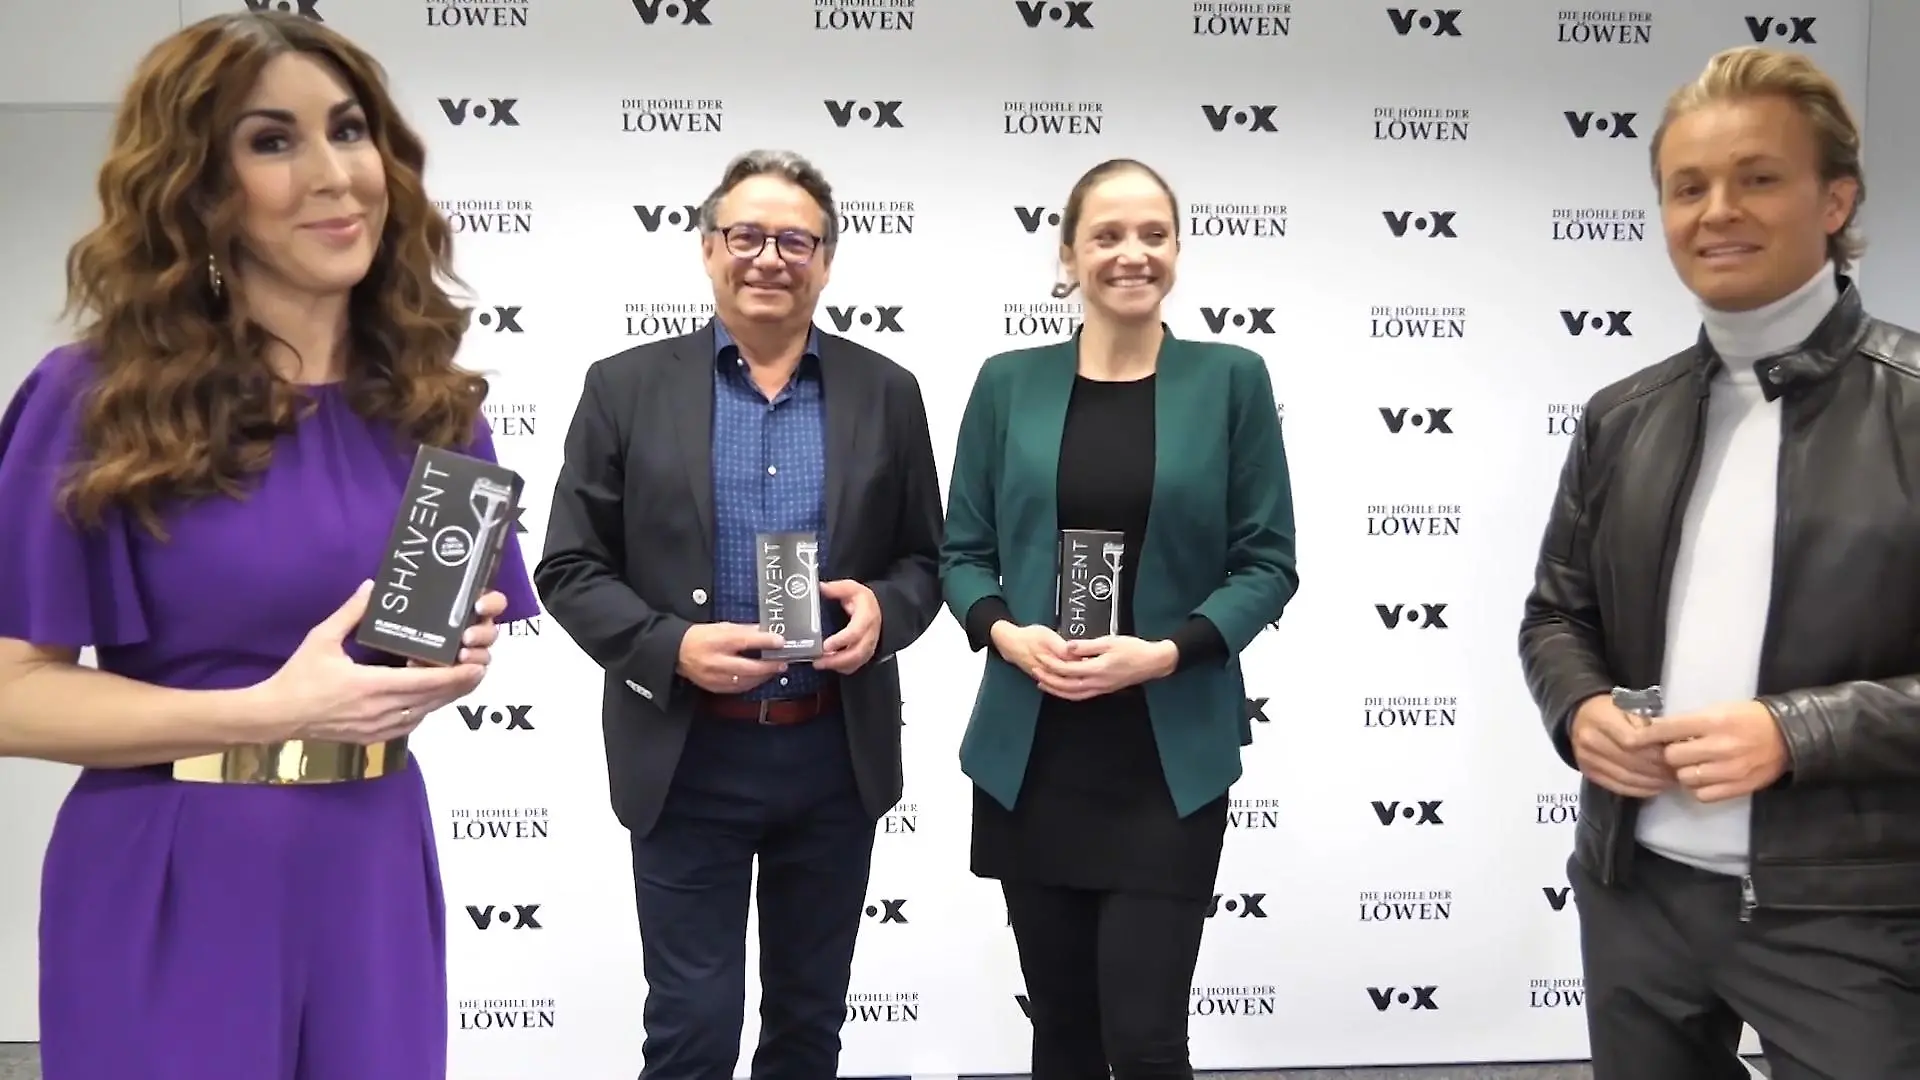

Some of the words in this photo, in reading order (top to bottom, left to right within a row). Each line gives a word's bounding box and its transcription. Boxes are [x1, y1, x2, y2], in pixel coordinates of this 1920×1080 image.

[426, 4, 528, 26] LÖWEN
[1193, 3, 1213, 13] DIE
[1267, 3, 1291, 13] DER
[1558, 11, 1577, 21] DIE
[1629, 11, 1652, 21] DER
[815, 8, 915, 30] LÖWEN
[1193, 14, 1291, 36] LÖWEN
[1558, 22, 1652, 44] LÖWEN
[622, 99, 642, 109] DIE
[698, 99, 723, 109] DER
[1004, 101, 1024, 111] DIE
[1079, 101, 1103, 111] DER
[1374, 108, 1393, 118] DIE
[1446, 108, 1470, 118] DER
[622, 110, 723, 132] LÖWEN
[1004, 112, 1103, 134] LÖWEN
[1374, 119, 1470, 140] LÖWEN
[507, 201, 532, 210] DER
[890, 201, 914, 211] DER
[1190, 205, 1210, 215] DIE
[1264, 205, 1288, 215] DER
[1552, 209, 1571, 219] DIE
[1624, 209, 1647, 219] DER
[448, 211, 531, 233] ÖWEN
[1013, 205, 1060, 232] VO
[1190, 215, 1288, 237] LÖWEN
[1552, 220, 1647, 241] LÖWEN
[479, 306, 524, 333] OX
[1370, 307, 1389, 315] DIE
[1442, 307, 1466, 315] DER
[625, 313, 704, 336] LÖWE
[1004, 313, 1080, 336] LÖWE
[1370, 316, 1466, 338] LÖWEN
[1367, 505, 1386, 513] DIE
[1438, 505, 1461, 513] DER
[1367, 514, 1461, 535] LÖWEN
[1364, 697, 1382, 705] DIE
[1433, 697, 1456, 705] DER
[1364, 706, 1456, 727] LÖWEN
[452, 809, 471, 818] DIE
[525, 809, 549, 818] DER
[1228, 810, 1278, 829] WEN
[452, 819, 549, 839] LÖWEN
[1360, 891, 1378, 900] DIE
[1429, 891, 1452, 900] DER
[865, 899, 909, 924] OX
[1360, 900, 1452, 921] LÖWEN
[460, 1000, 479, 1008] DIE
[532, 1000, 555, 1008] DER
[1530, 988, 1584, 1007] LÖW
[460, 1009, 555, 1029] LÖWEN
